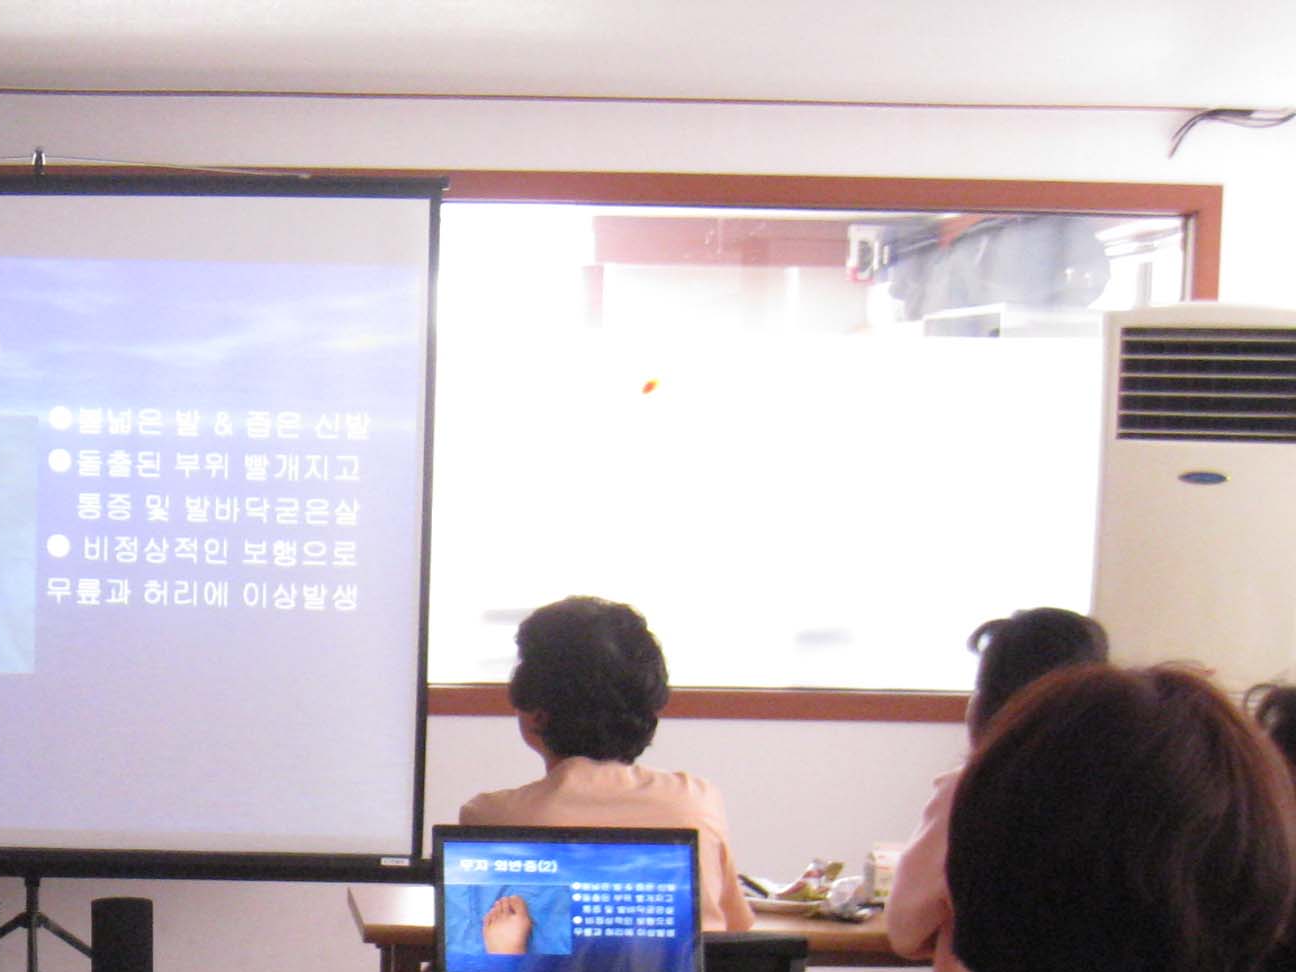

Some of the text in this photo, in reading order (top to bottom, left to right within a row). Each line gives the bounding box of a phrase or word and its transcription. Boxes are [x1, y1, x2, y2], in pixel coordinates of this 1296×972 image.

[175, 408, 201, 438] 발
[213, 411, 234, 438] &
[246, 410, 303, 440] 좁은
[313, 411, 371, 441] 신발
[77, 449, 361, 482] 돌출된 부위 빨개지고
[77, 492, 361, 527] 통증 및 발바닥굳은살
[83, 535, 359, 568] 비정상적인 보행으로
[47, 577, 359, 612] 무릎과 허리에 이상발생
